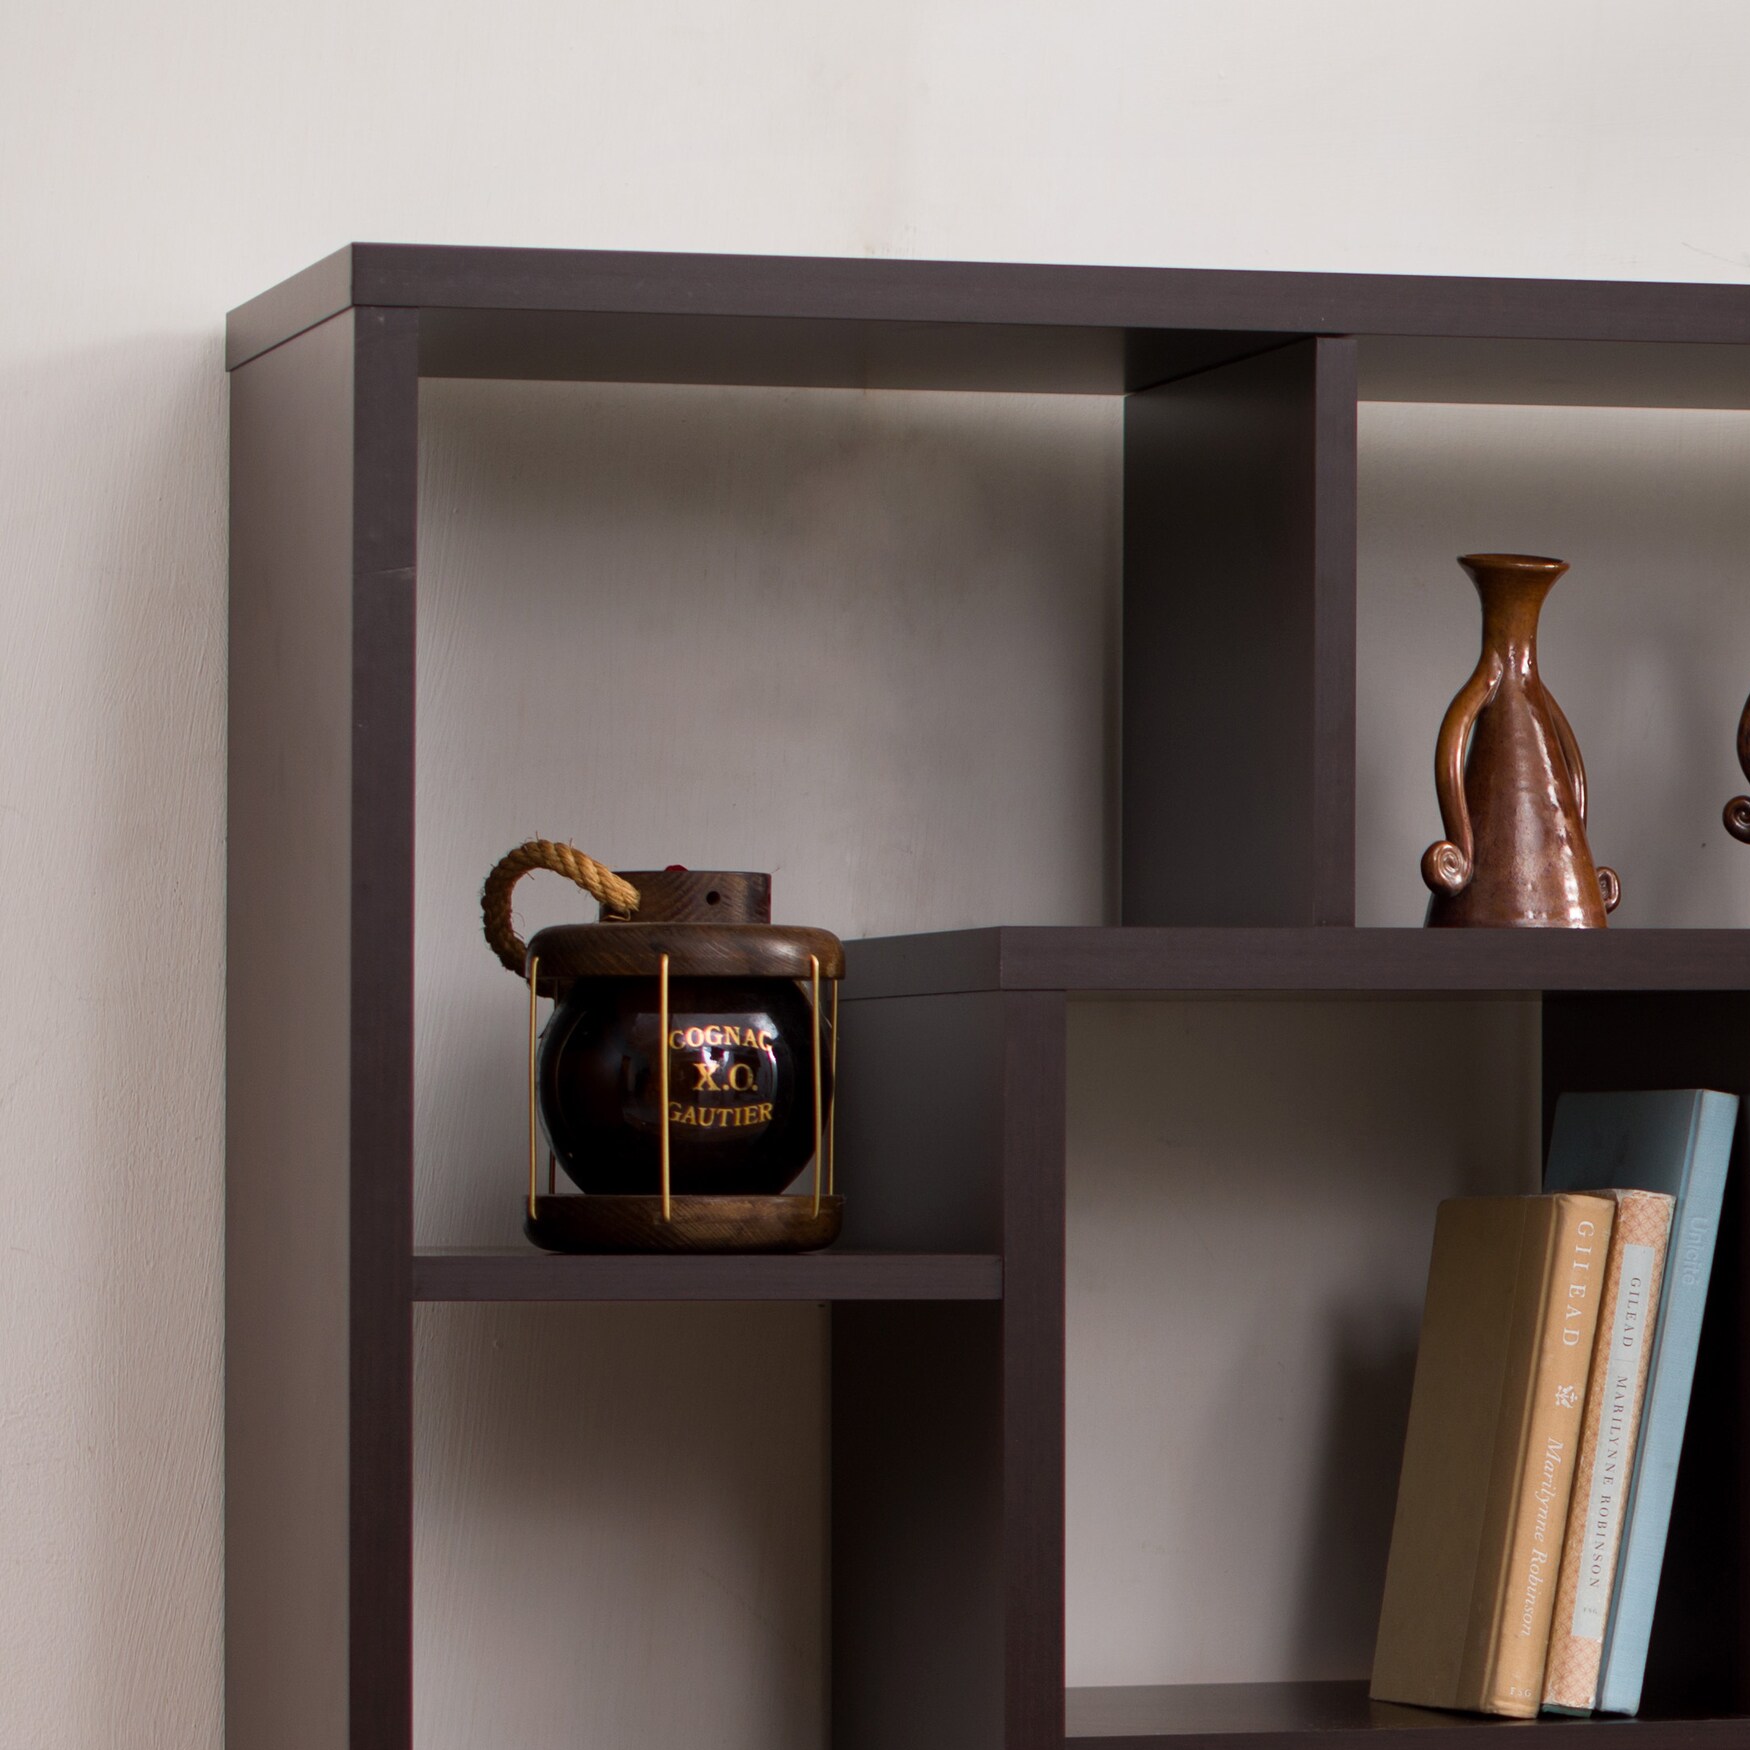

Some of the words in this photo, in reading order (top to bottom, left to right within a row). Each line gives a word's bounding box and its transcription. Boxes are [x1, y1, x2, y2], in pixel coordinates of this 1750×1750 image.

[669, 1024, 773, 1052] COGNAC
[692, 1062, 759, 1092] X.O.
[668, 1101, 774, 1127] GAUTIER
[1562, 1220, 1596, 1347] GILEAD
[1622, 1277, 1642, 1347] GILEAD
[1602, 1375, 1628, 1485] MARILYNNE
[1532, 1436, 1564, 1543] Marilynne
[1589, 1494, 1612, 1587] ROBINSON
[1519, 1547, 1548, 1637] Robinson
